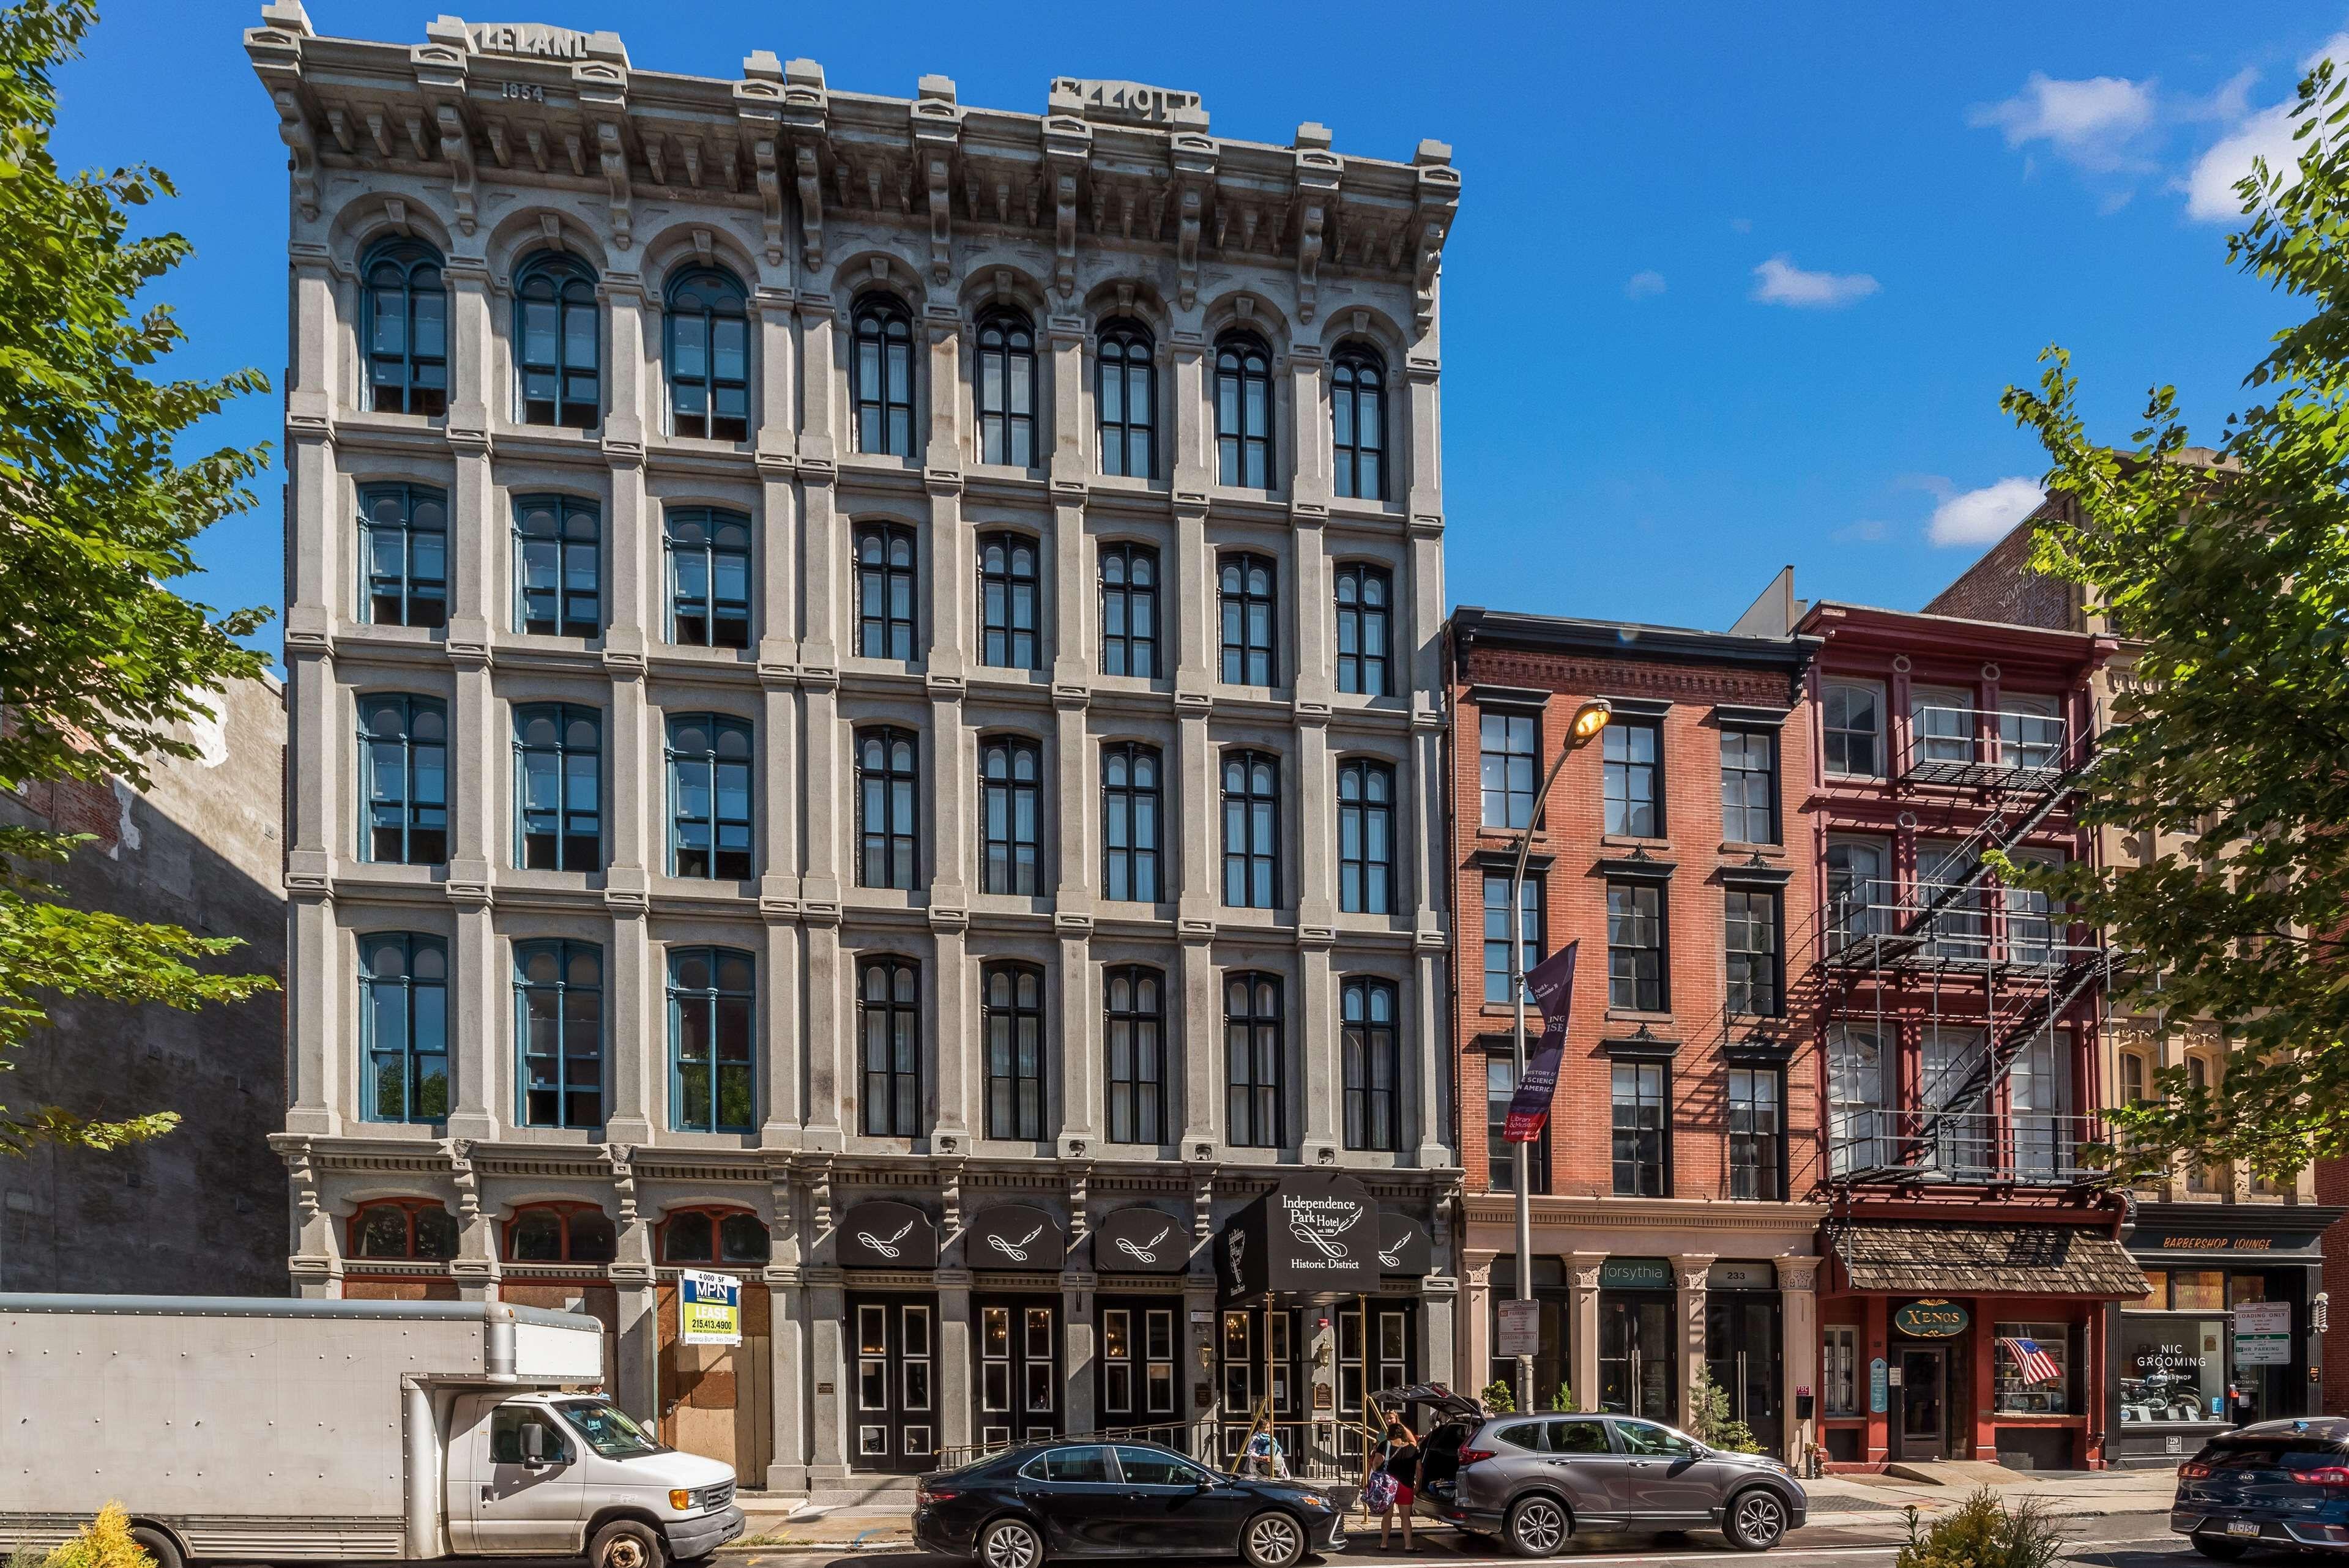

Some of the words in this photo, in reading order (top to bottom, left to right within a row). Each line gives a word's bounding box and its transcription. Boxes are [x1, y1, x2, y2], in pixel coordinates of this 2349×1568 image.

[502, 82, 544, 102] 1854
[1282, 1194, 1355, 1211] Independence
[1290, 1209, 1316, 1223] Park
[1316, 1214, 1339, 1227] Hotel
[2164, 1237, 2228, 1249] BARBERSHOP
[2233, 1238, 2272, 1250] LOUNGE
[1292, 1258, 1326, 1269] Historic
[1328, 1258, 1359, 1269] District
[1604, 1264, 1663, 1280] forsythia
[696, 1281, 728, 1298] MPN
[696, 1306, 729, 1320] LEASE
[1907, 1310, 1960, 1325] XENOS
[692, 1319, 732, 1329] 215.413.4900
[2161, 1344, 2183, 1354] NIC
[2137, 1357, 2206, 1367] GROOMING
